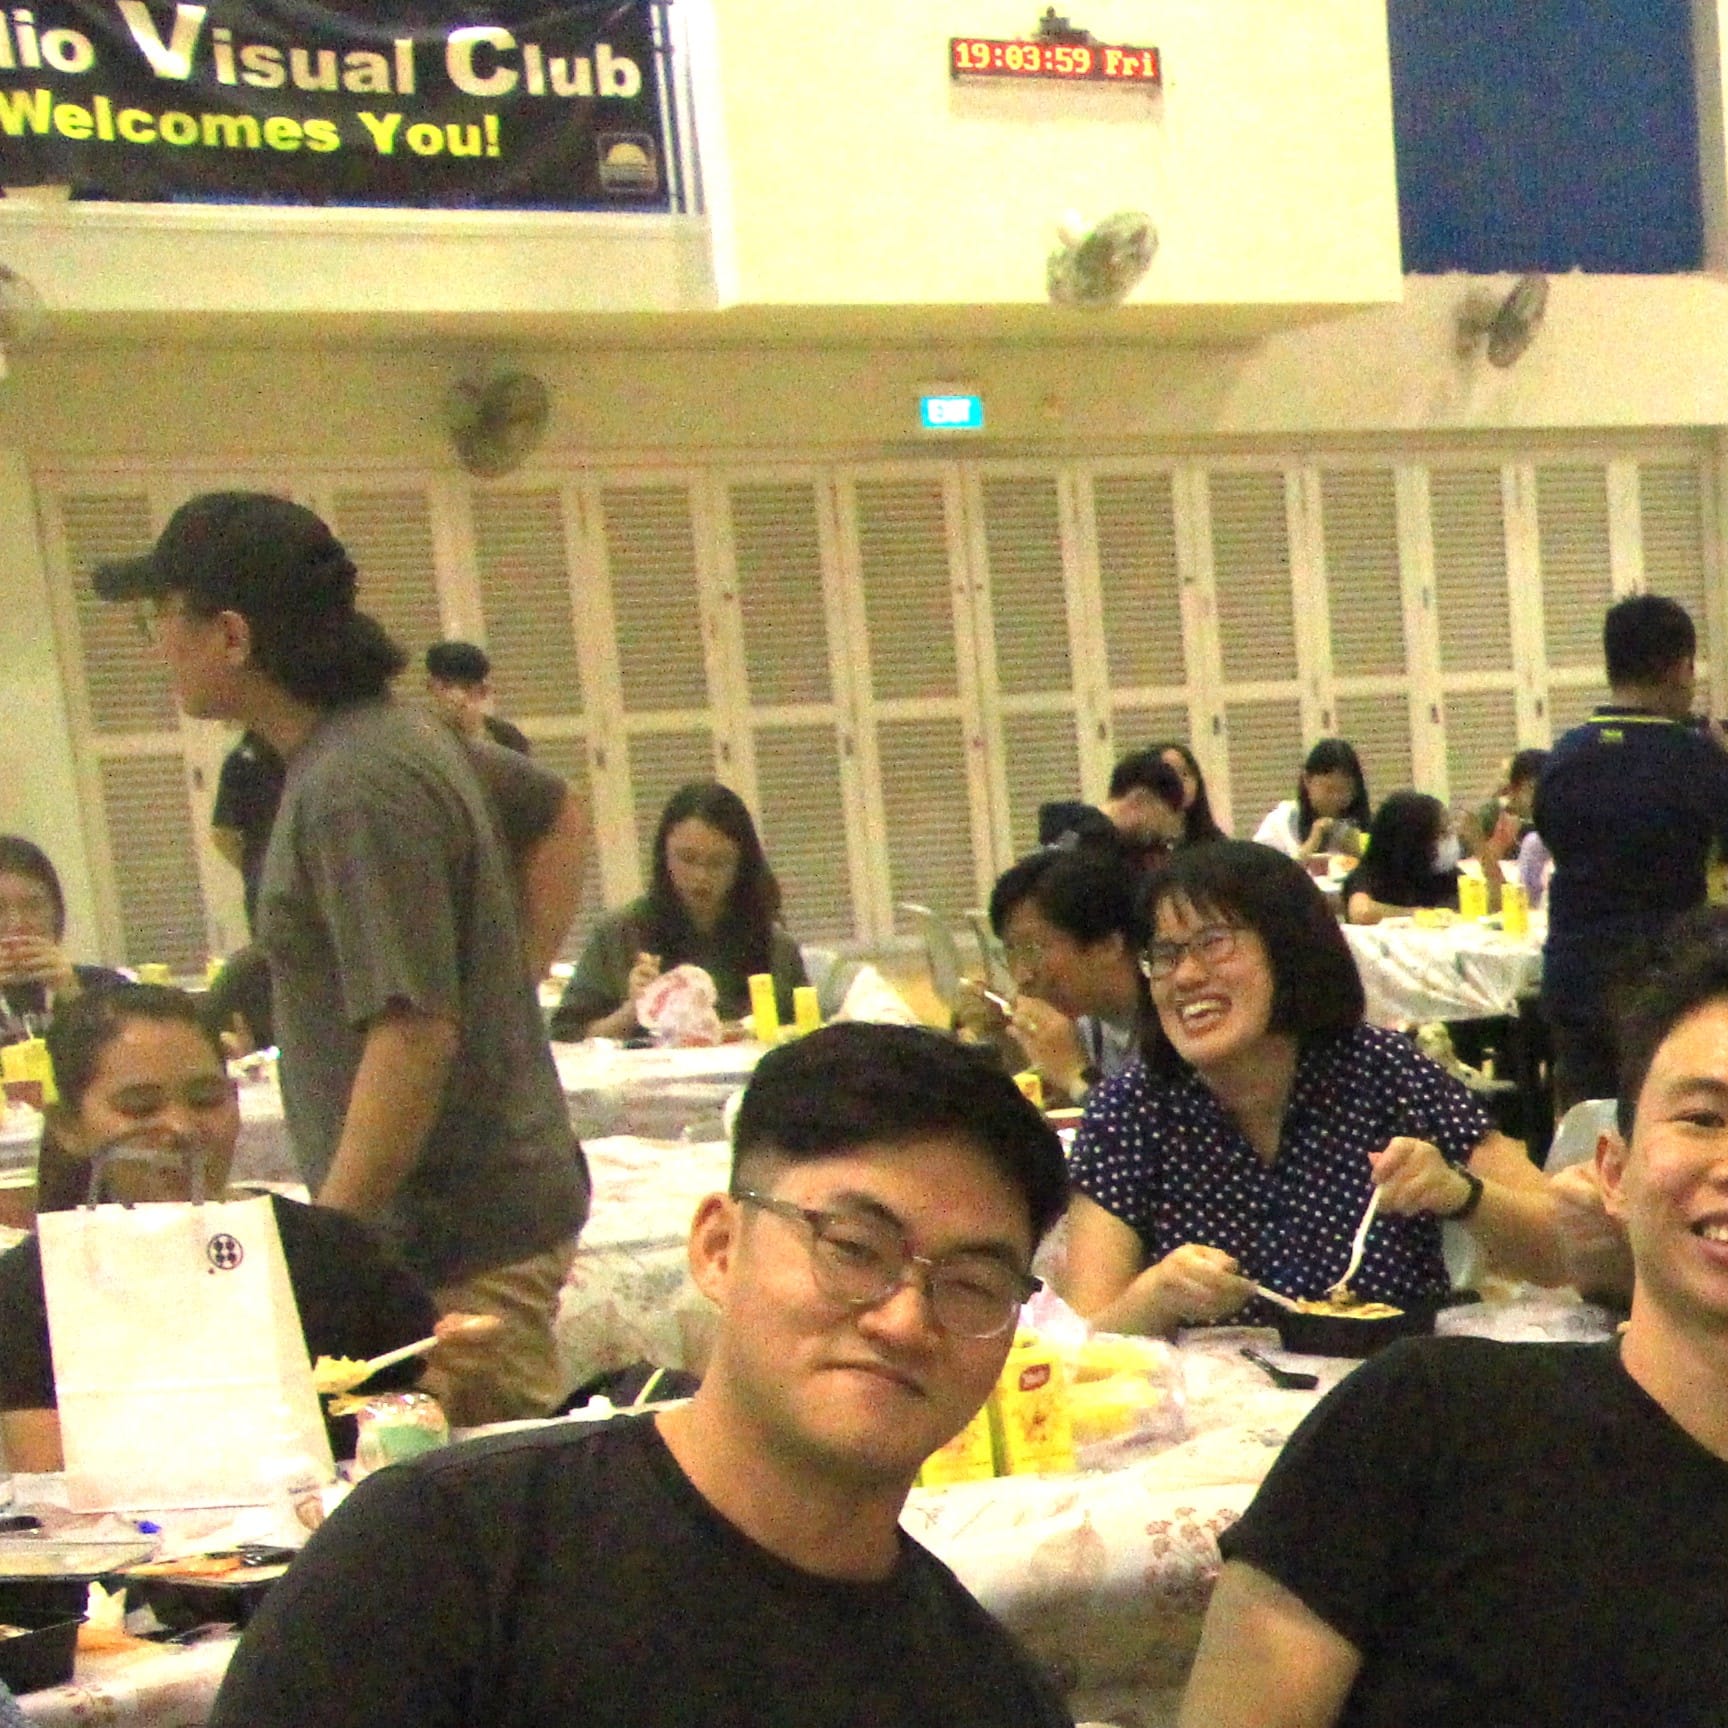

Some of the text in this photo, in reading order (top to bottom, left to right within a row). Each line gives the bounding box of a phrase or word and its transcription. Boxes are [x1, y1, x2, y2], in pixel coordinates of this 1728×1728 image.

[114, 0, 417, 94] Visual
[445, 26, 643, 97] Club
[956, 42, 1154, 76] 19:03:59 Fri
[0, 88, 501, 157] Welcomes You!
